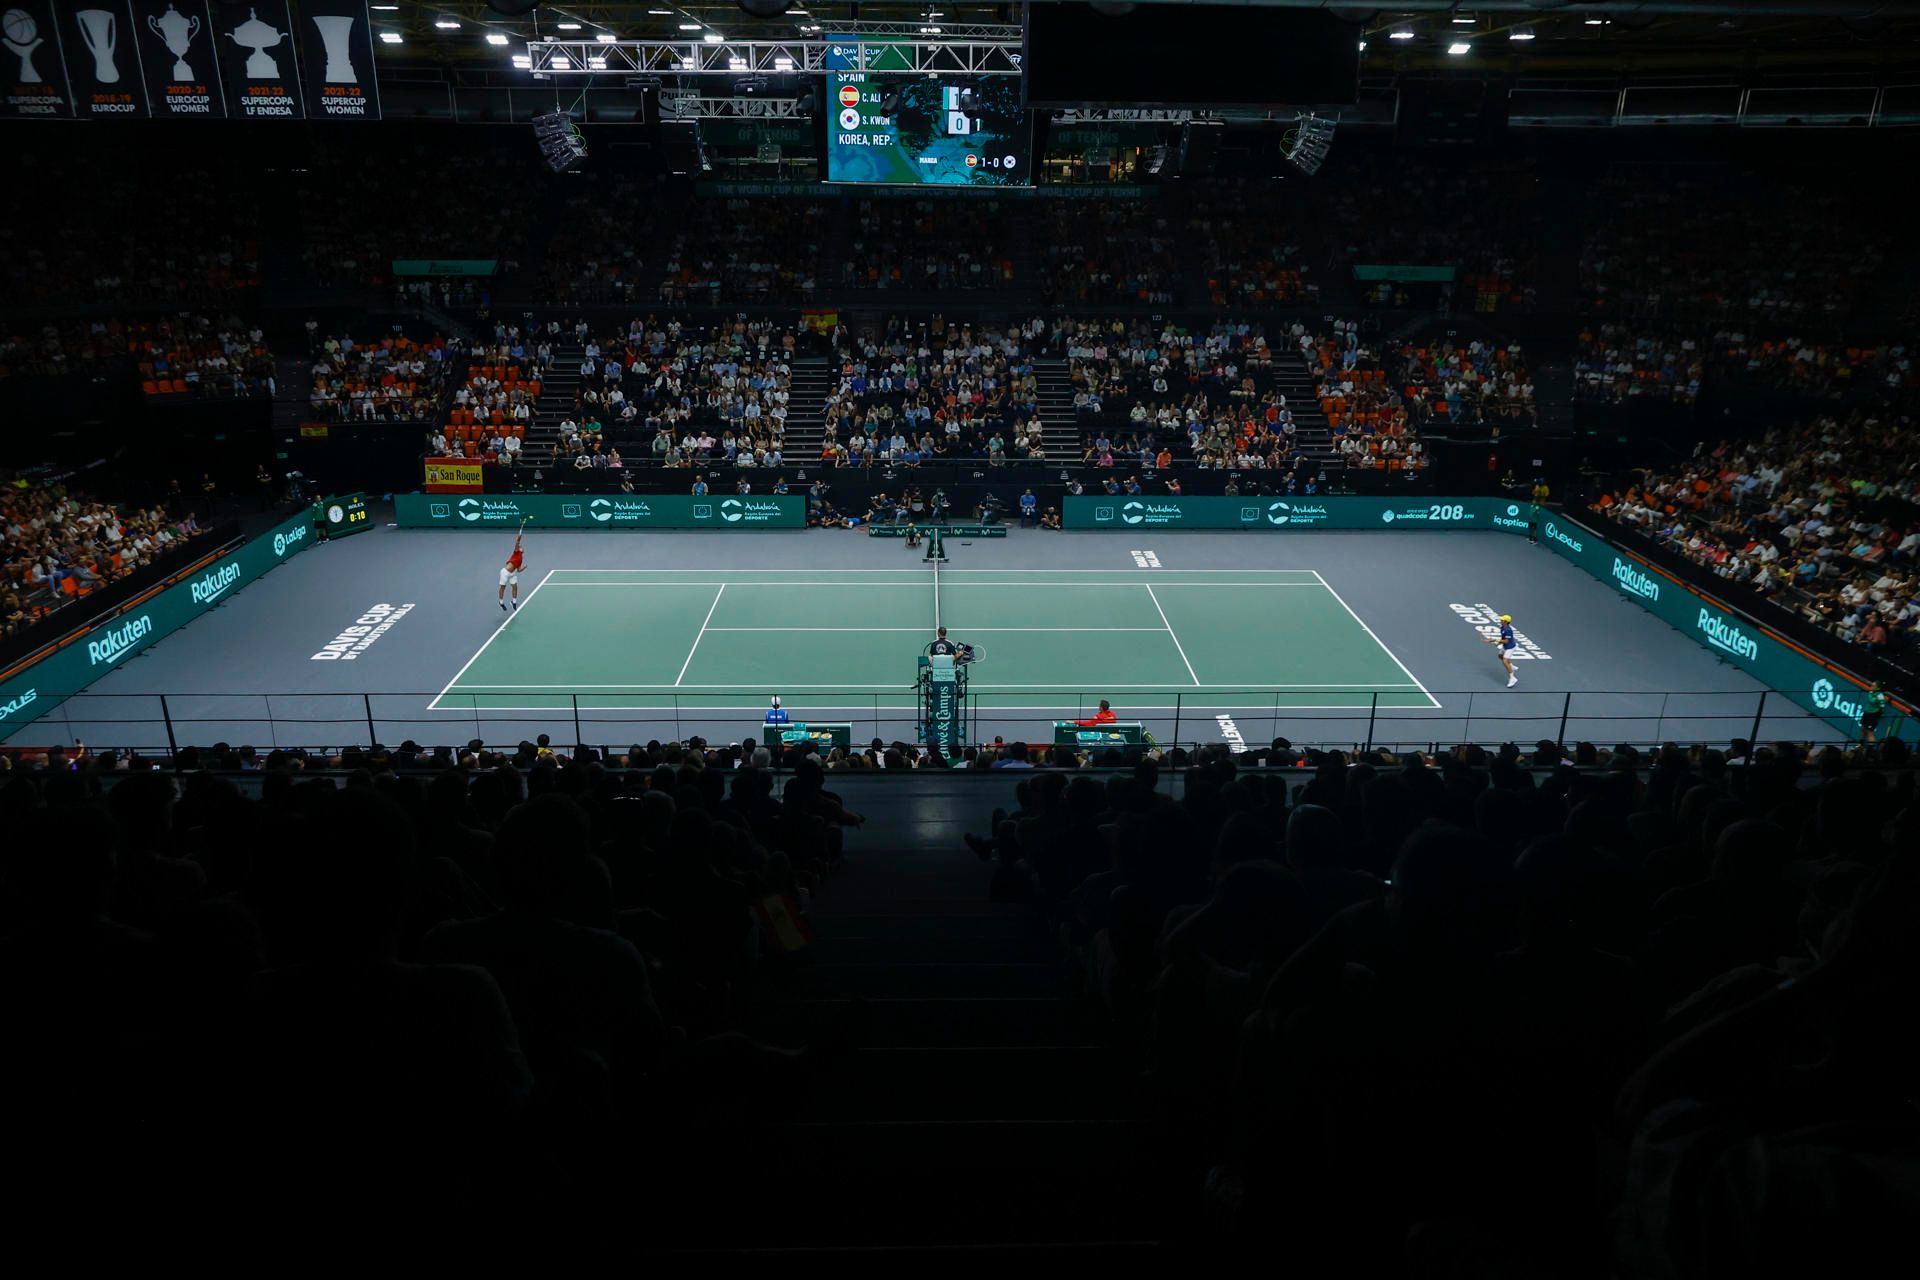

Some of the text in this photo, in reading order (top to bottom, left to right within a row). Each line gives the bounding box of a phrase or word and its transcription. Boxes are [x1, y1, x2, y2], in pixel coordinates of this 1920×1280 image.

[838, 73, 865, 82] SPAIN
[166, 96, 210, 104] EUROCUP
[241, 97, 295, 106] SUPERCOPA
[321, 97, 366, 106] SUPERCUP
[862, 93, 869, 102] C.
[91, 104, 136, 113] EUROCUP
[171, 104, 209, 113] WOMEN
[257, 107, 293, 116] ENDESA
[326, 106, 365, 115] WOMEN
[862, 116, 890, 125] S. KWON
[957, 118, 963, 130] 0
[976, 118, 981, 131] 1
[839, 134, 893, 146] KOREA, REP.
[440, 469, 480, 484] San Roque
[350, 510, 366, 522] 0:10
[1429, 505, 1464, 520] 208
[1494, 515, 1528, 528] iq option
[285, 525, 306, 545] LaLiga
[1555, 530, 1582, 552] LEXUS
[191, 562, 240, 603] Rakuten
[1612, 557, 1659, 601] Rakuten
[1449, 603, 1490, 624] CUP
[310, 603, 395, 660] DAVIS CUP
[1697, 608, 1758, 661] Rakuten
[88, 615, 152, 665] Rakuten
[1834, 694, 1864, 726] LaLi
